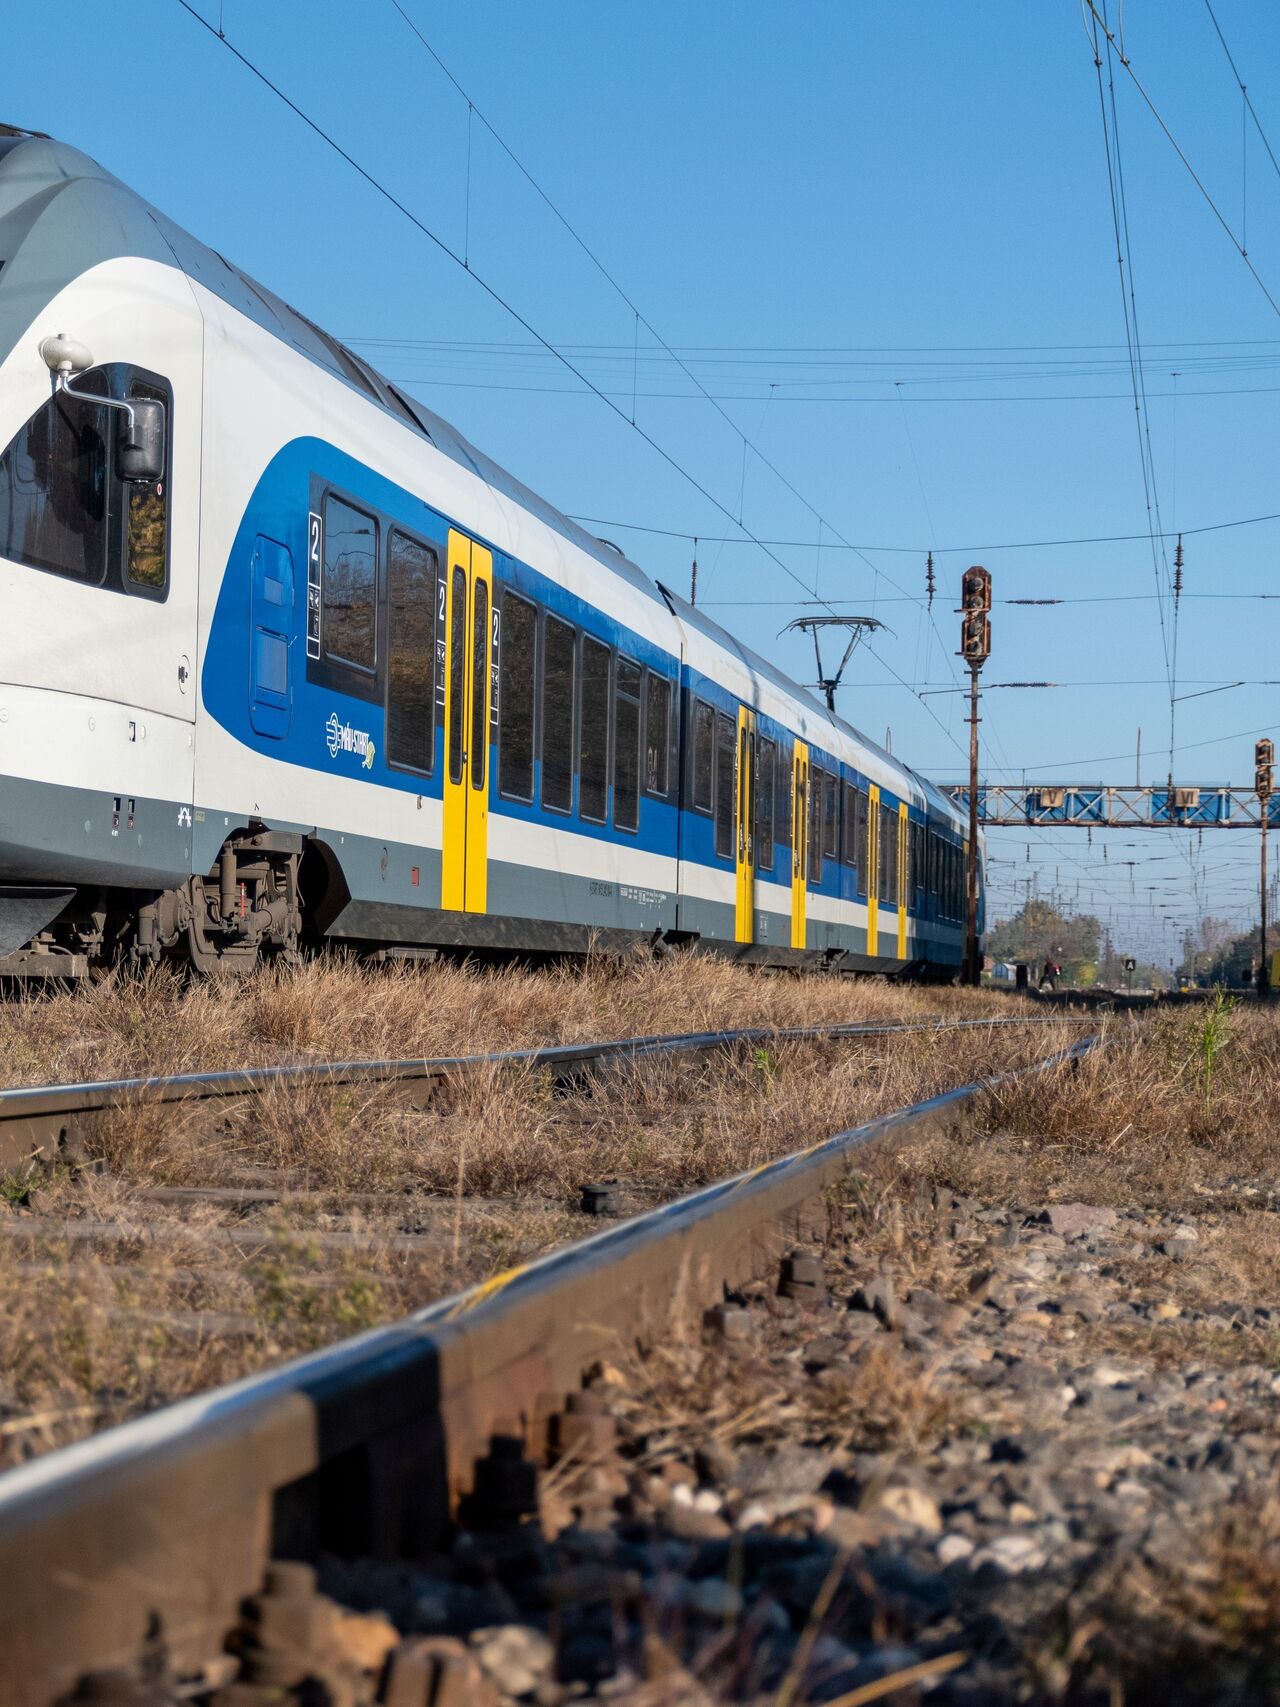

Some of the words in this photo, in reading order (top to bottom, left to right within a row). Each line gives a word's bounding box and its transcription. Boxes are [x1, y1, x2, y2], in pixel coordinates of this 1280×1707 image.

[311, 520, 319, 561] 2
[439, 586, 445, 621] 2
[493, 613, 499, 647] 2
[1048, 790, 1057, 804] V
[1181, 791, 1193, 804] VI
